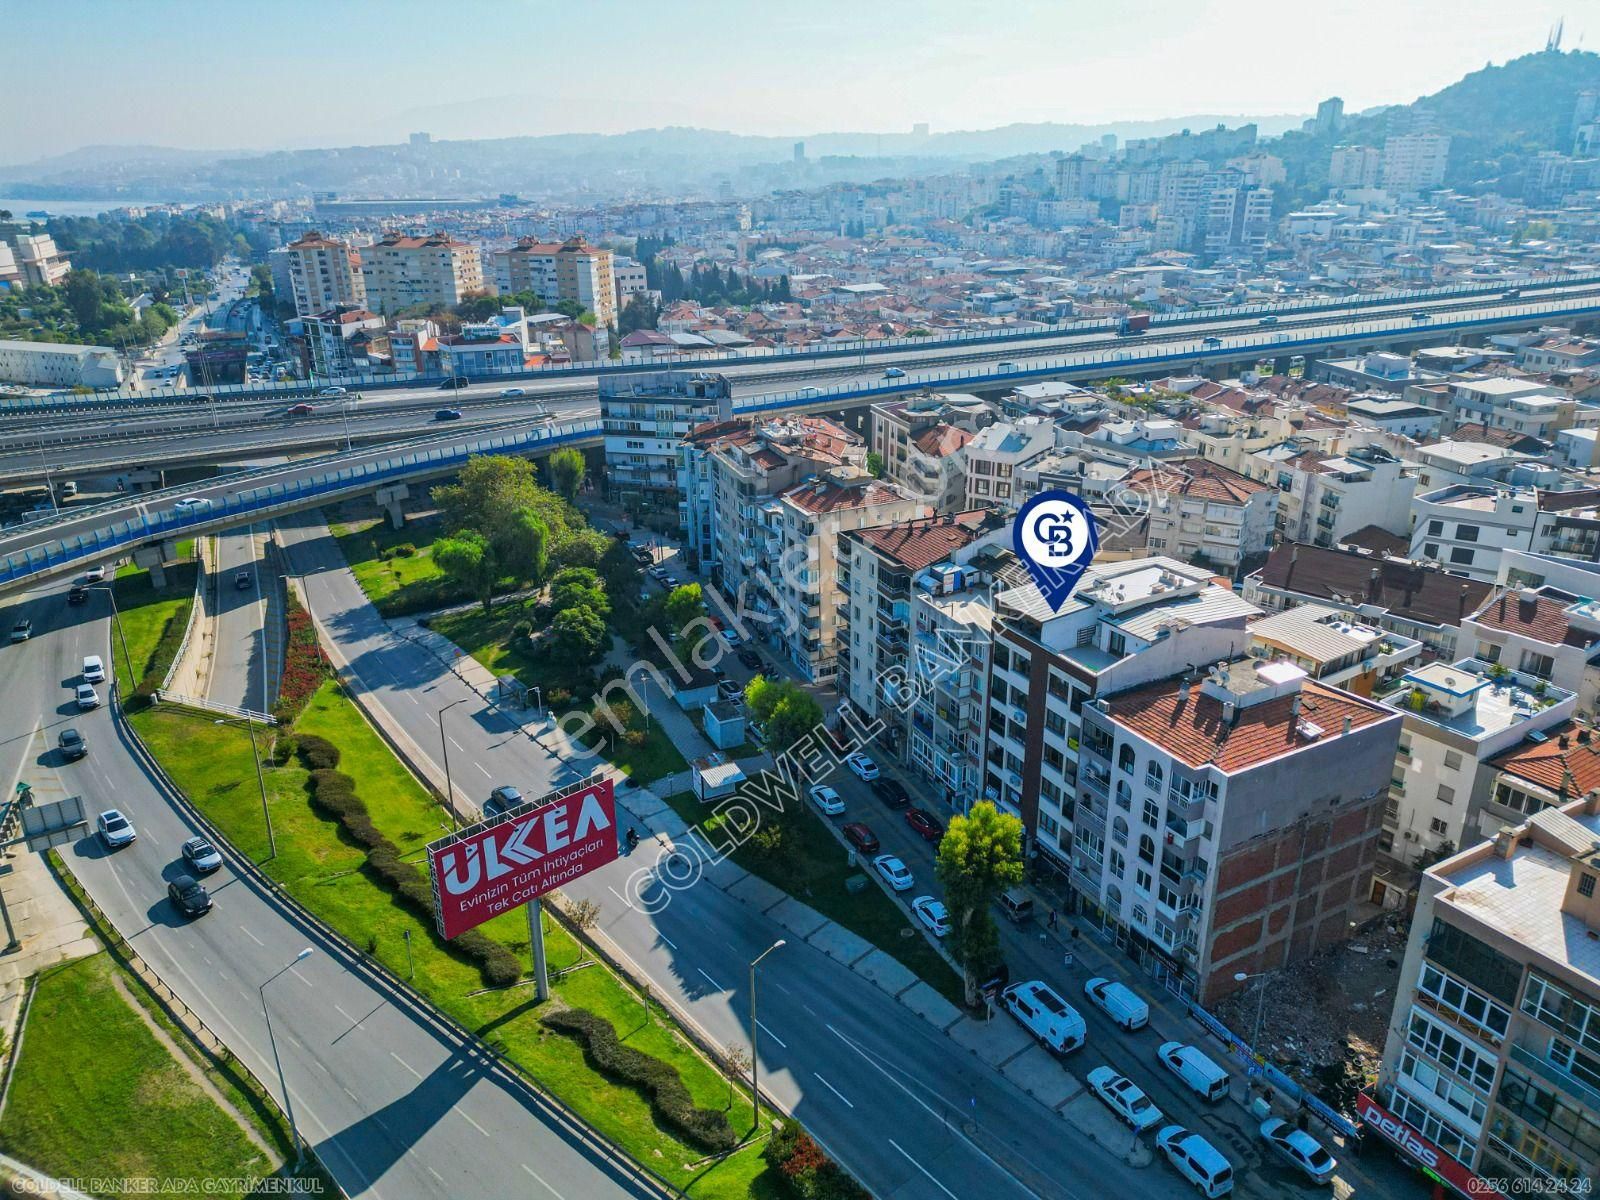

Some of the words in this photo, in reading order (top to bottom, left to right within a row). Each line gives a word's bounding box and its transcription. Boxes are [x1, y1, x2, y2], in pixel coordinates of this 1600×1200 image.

[460, 882, 510, 912] Evinizin
[512, 866, 541, 888] Tüm
[543, 839, 604, 872] İhtiyaçları
[487, 898, 510, 915] Tek
[512, 884, 538, 904] Çatı
[541, 863, 584, 888] Altında
